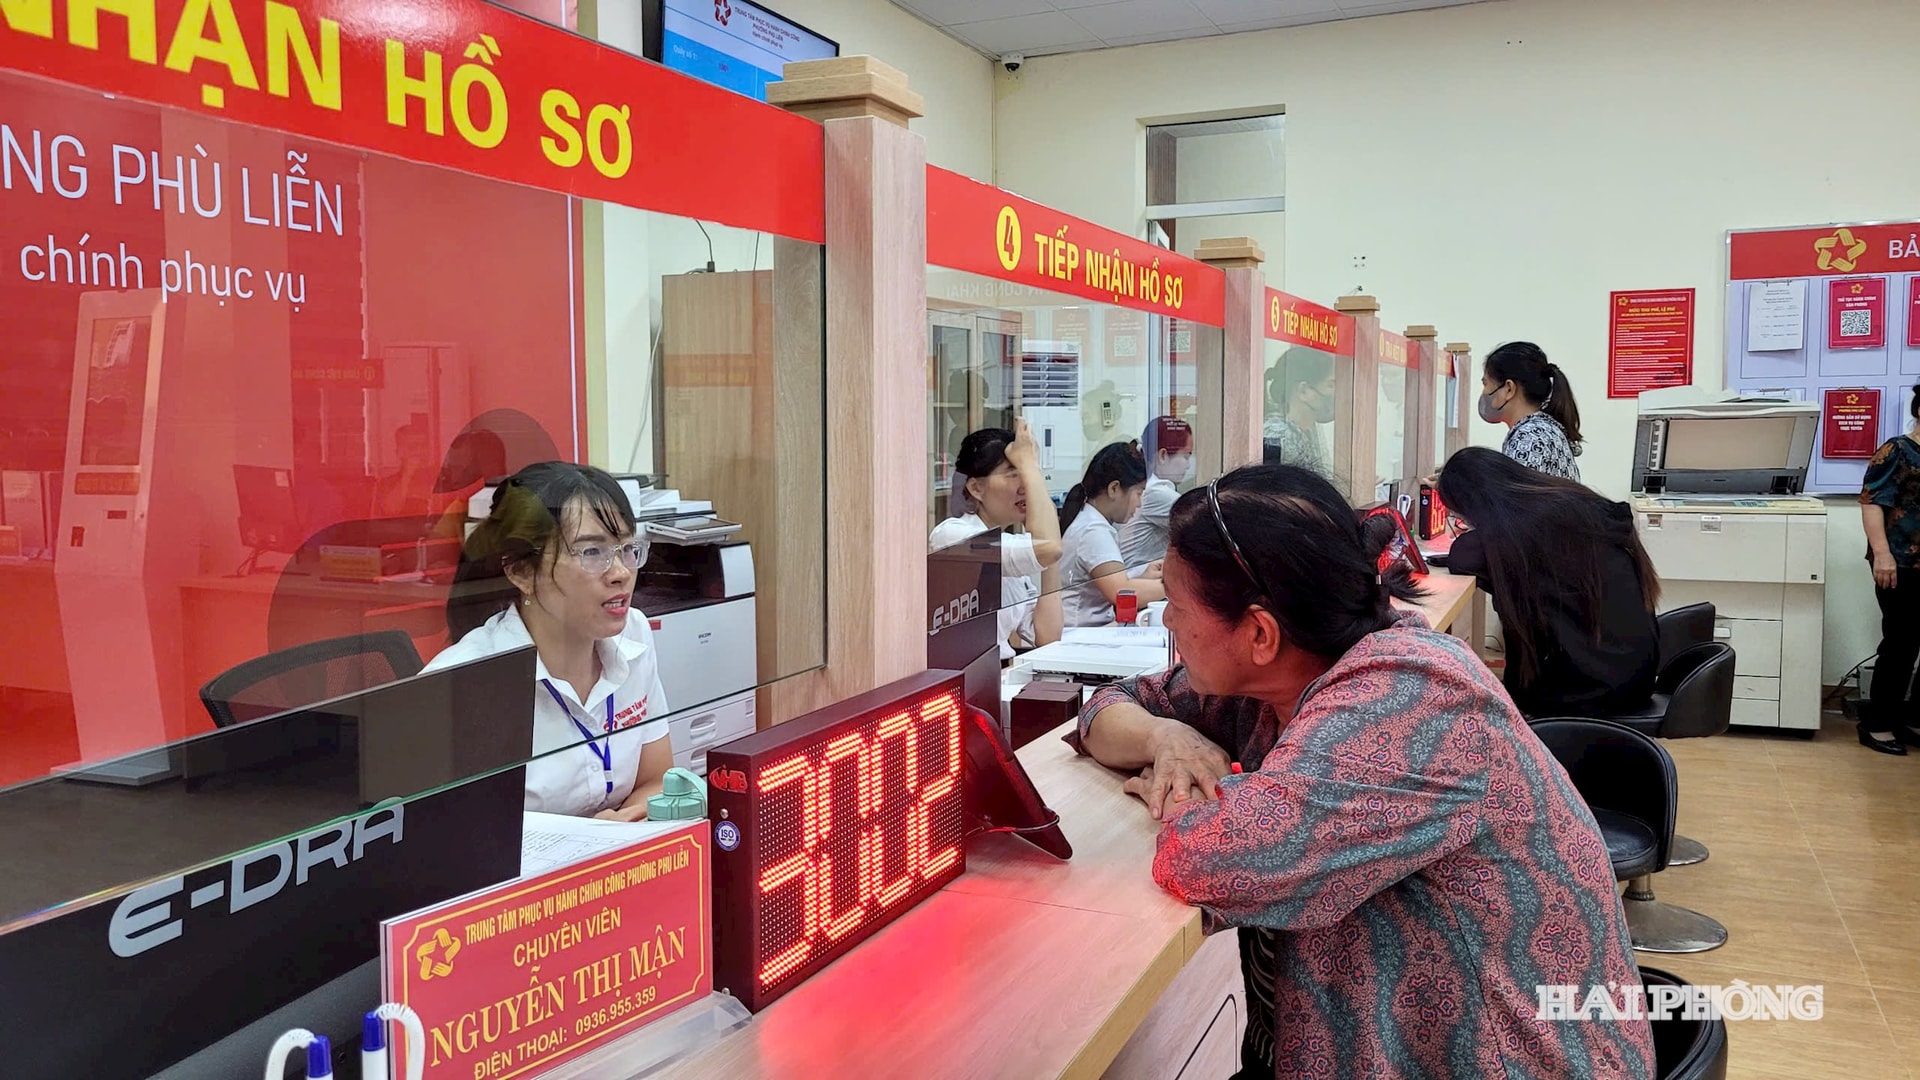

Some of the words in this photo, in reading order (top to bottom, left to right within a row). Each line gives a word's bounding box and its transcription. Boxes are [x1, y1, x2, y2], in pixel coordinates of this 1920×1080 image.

[385, 33, 509, 149] HỒ
[540, 88, 633, 179] SƠ
[1, 124, 89, 199] NG
[112, 143, 222, 218] PHÙ
[242, 150, 343, 236] LIỄN
[20, 233, 144, 289] chính
[160, 250, 253, 306] phục
[265, 270, 306, 312] vụ
[1034, 225, 1079, 281] TIẾP
[1085, 248, 1135, 302] NHẬN
[1139, 257, 1161, 304] HỒ
[1164, 274, 1184, 309] SƠ
[1888, 233, 1920, 259] BẢ
[1283, 302, 1299, 336] TIẾP
[928, 588, 980, 636] E-DRA
[108, 796, 405, 958] E-DRA
[720, 829, 735, 839] ISO
[758, 694, 961, 985] 3002
[465, 916, 496, 946] TRUNG
[497, 907, 517, 938] TÂM
[518, 902, 542, 928] PHỤC
[543, 896, 555, 921] VỤ
[556, 888, 578, 918] HÀNH
[579, 877, 603, 905] CHÍNH
[604, 870, 626, 896] CÔNG
[627, 860, 657, 888] PHƯỜNG
[657, 851, 673, 876] PHÙ
[673, 844, 689, 870] LIỄN
[513, 921, 582, 967] CHUYÊN
[585, 906, 622, 939] VIÊN
[430, 964, 566, 1068] NGUYỄN
[572, 952, 622, 1005] THỊ
[628, 924, 687, 982] MẬN
[474, 1050, 513, 1080] ĐIỆN
[516, 1026, 568, 1062] THOẠI:
[575, 985, 657, 1036] 0936.955.359
